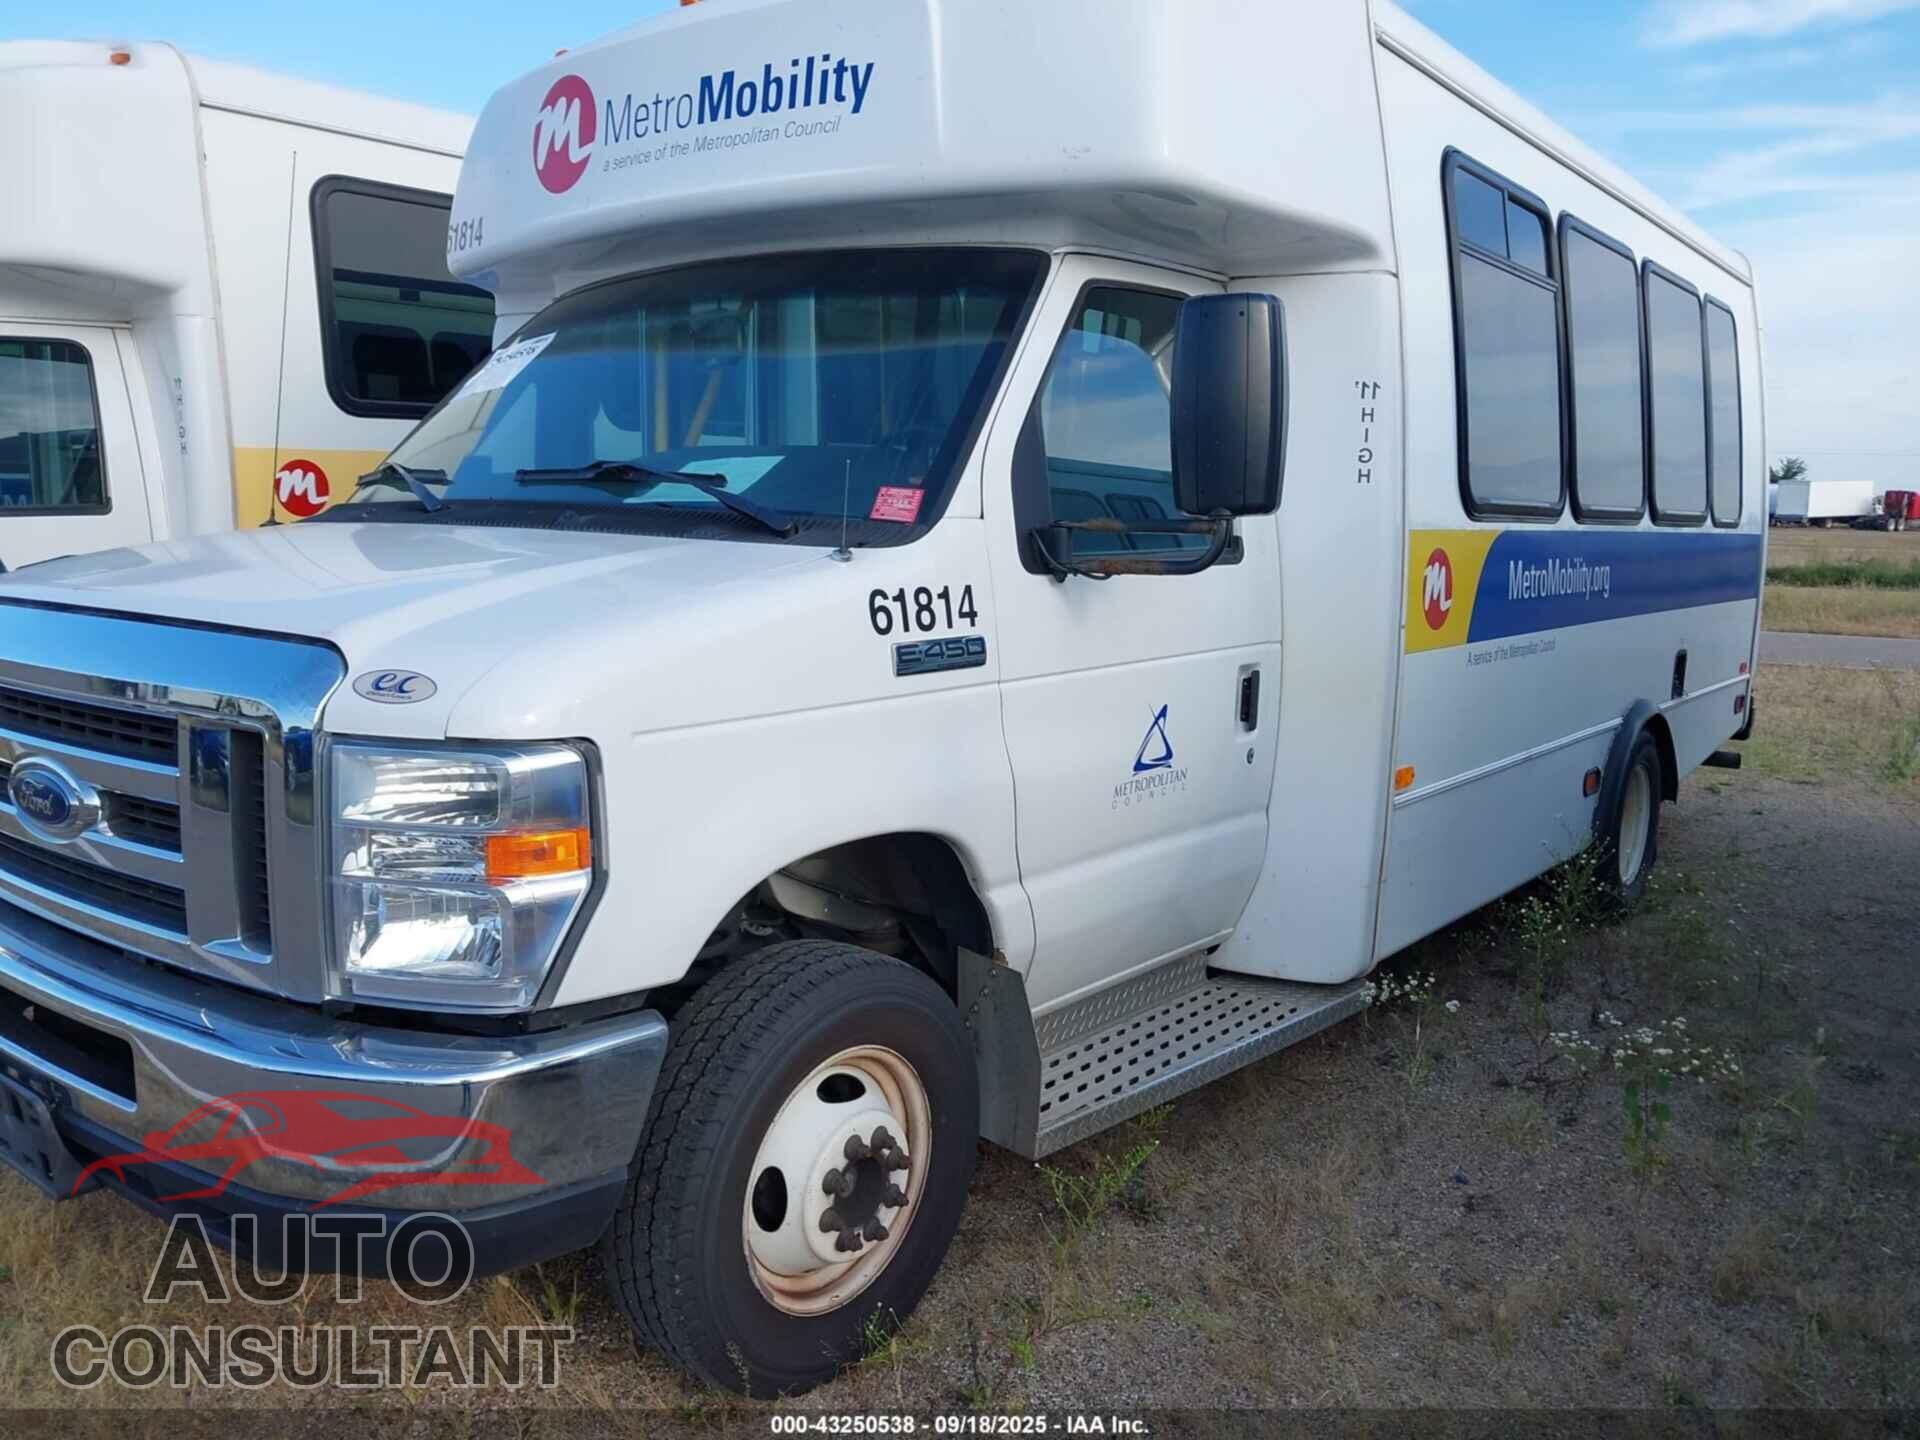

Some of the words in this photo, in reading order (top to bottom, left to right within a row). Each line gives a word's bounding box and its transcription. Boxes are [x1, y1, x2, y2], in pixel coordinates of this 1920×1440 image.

[604, 53, 874, 146] MetroMobility
[602, 162, 610, 173] a
[612, 150, 652, 171] service
[654, 145, 668, 162] of
[669, 142, 689, 159] the
[693, 126, 780, 153] Metropolitan
[784, 116, 843, 140] Council
[1508, 556, 1611, 601] MetroMobility.org
[869, 584, 978, 635] 61814
[895, 637, 986, 665] E-450
[1113, 768, 1188, 798] METROPOLITAN
